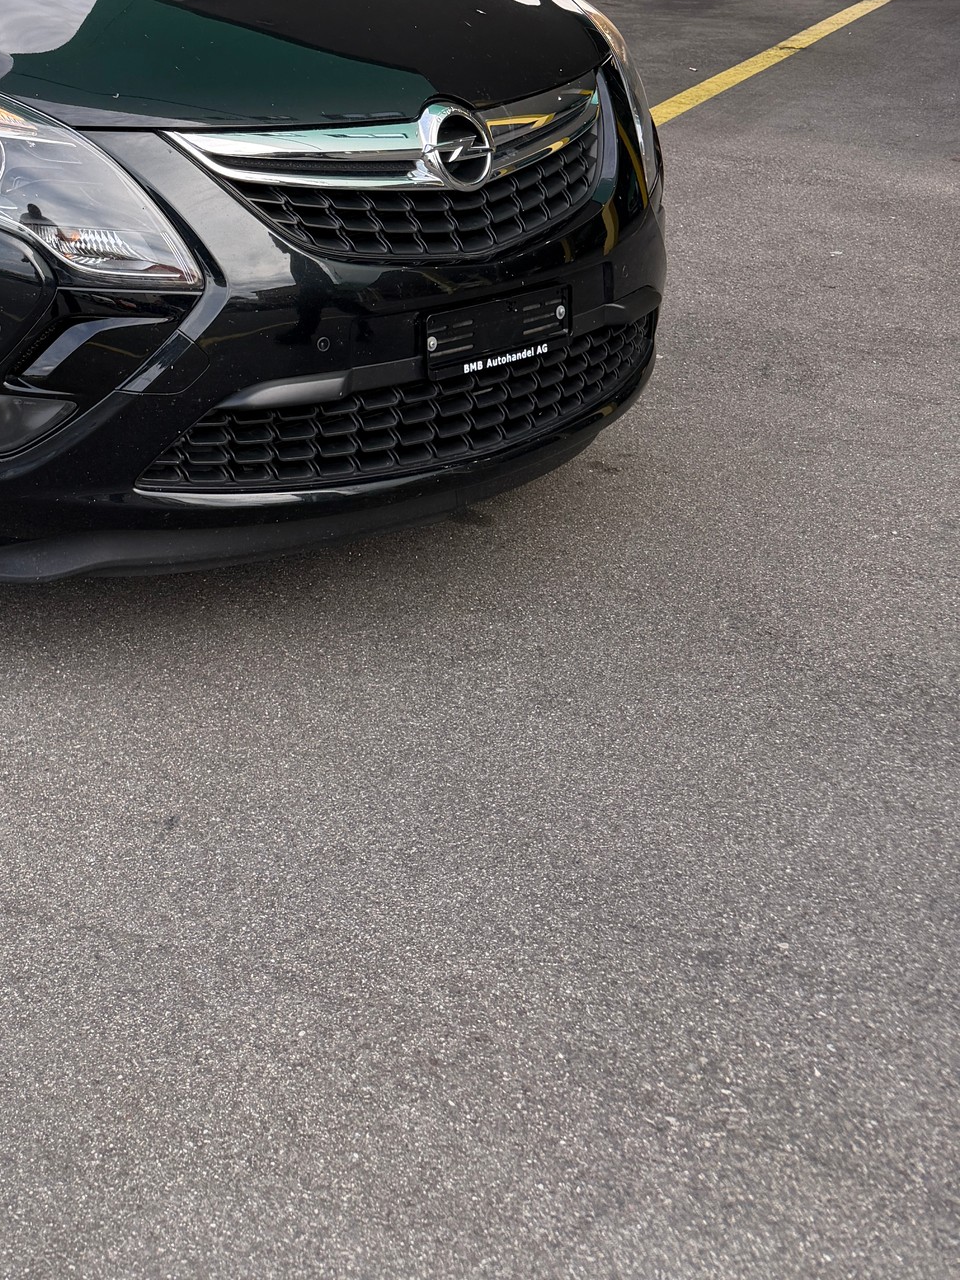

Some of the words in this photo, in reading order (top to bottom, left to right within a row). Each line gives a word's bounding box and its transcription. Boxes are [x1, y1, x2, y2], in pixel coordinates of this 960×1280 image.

[463, 360, 483, 373] BMB
[486, 347, 535, 368] Autohandel
[536, 343, 548, 355] AG
